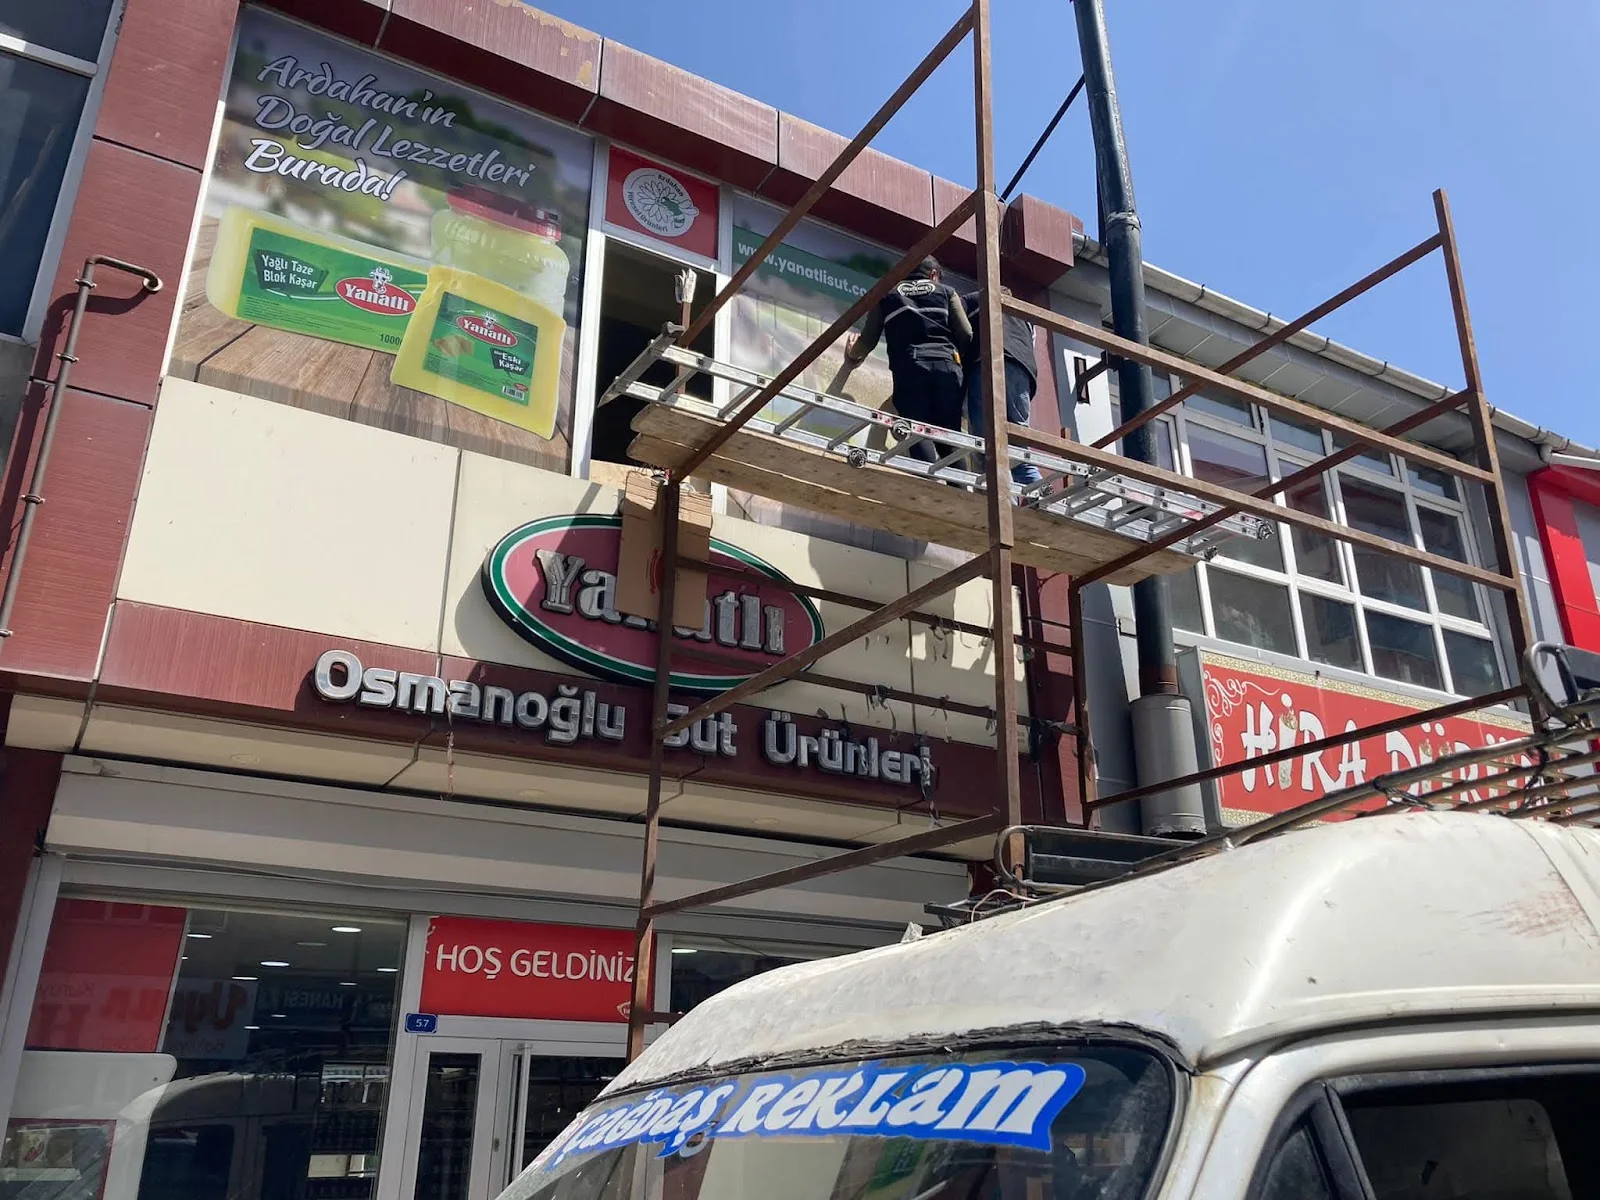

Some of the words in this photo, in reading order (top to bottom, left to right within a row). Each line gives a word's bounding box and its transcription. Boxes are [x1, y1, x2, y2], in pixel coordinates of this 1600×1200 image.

[255, 95, 377, 150] Doğal
[371, 125, 535, 187] Lezzetleri
[244, 138, 407, 201] Burada!
[261, 254, 289, 271] Yağlı
[291, 260, 314, 276] Taze
[263, 269, 286, 284] Blok
[288, 273, 318, 289] Kaşar
[344, 283, 409, 312] Yanatlı
[536, 549, 786, 655] Yatlı
[314, 649, 626, 742] Osmanoğlu
[764, 710, 931, 785] Ürünleri
[436, 944, 502, 979] HOŞ
[416, 1019, 430, 1028] 57
